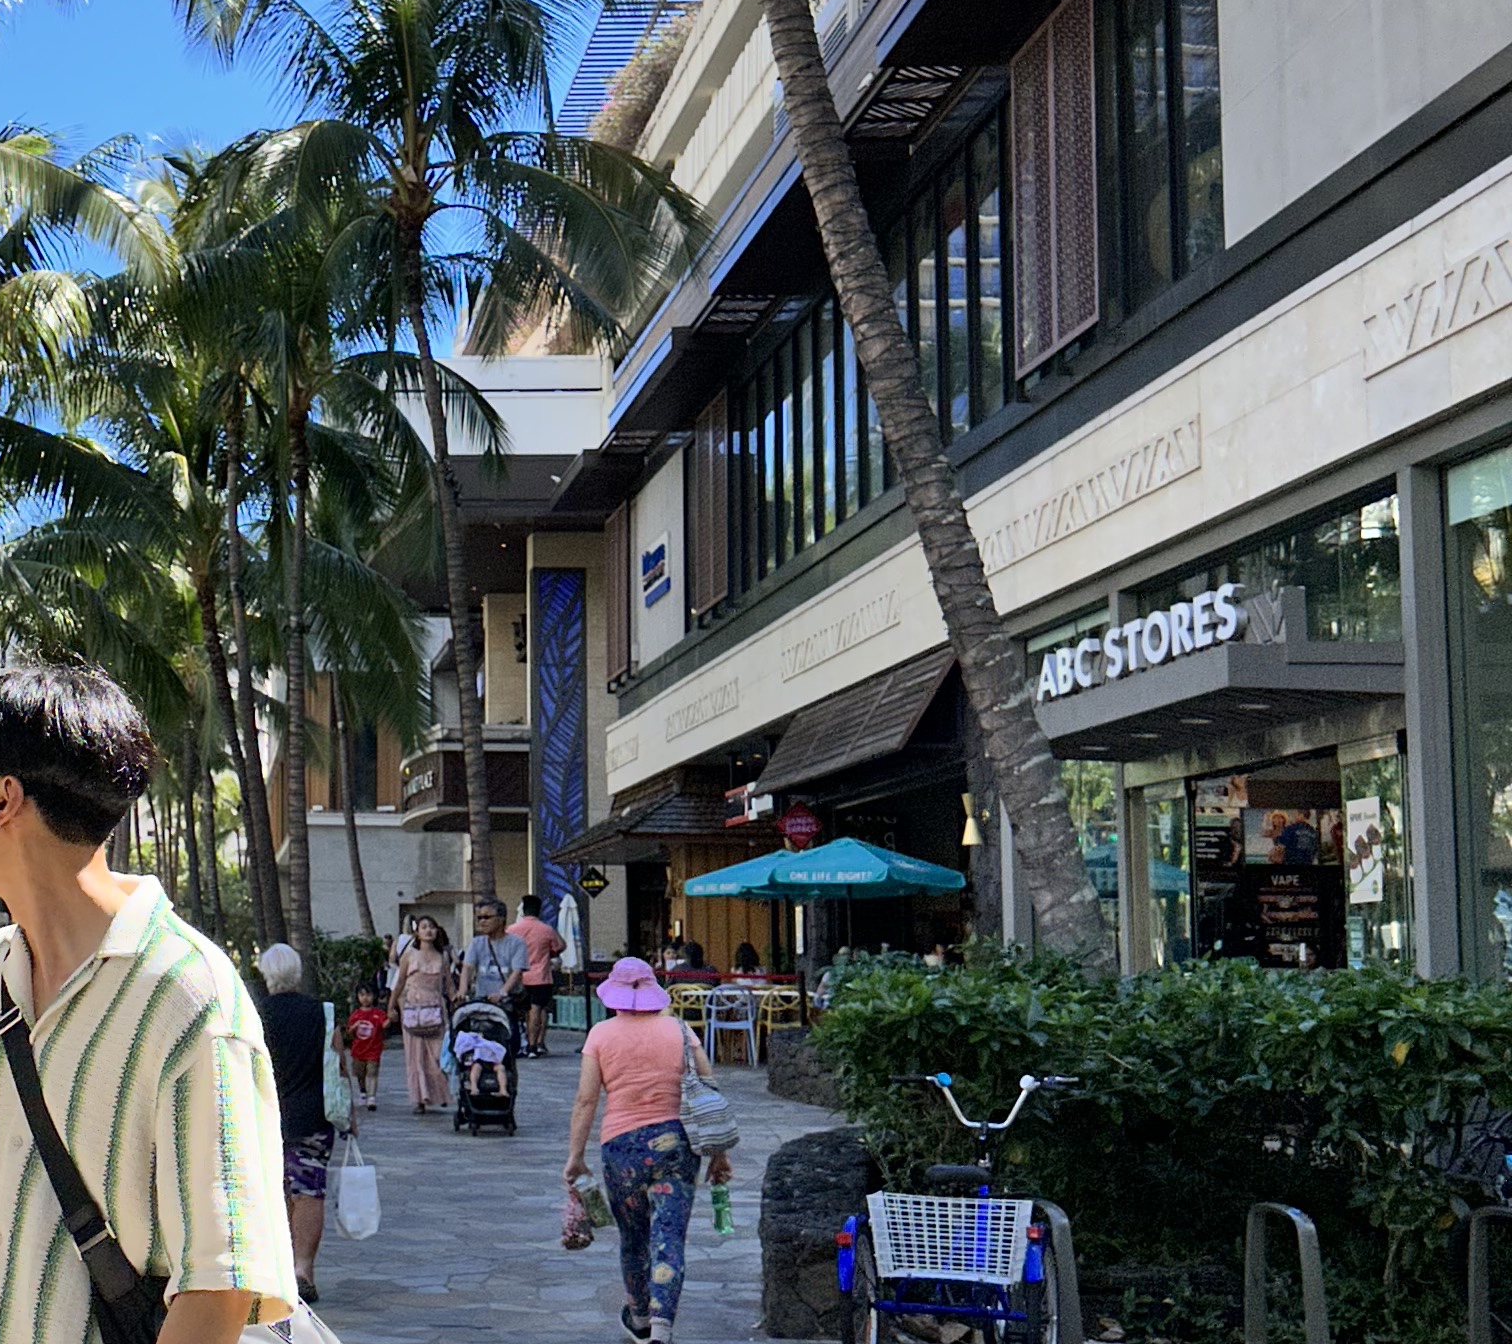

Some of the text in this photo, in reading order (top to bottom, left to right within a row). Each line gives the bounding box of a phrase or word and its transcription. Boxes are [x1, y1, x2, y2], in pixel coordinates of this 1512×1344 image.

[1037, 583, 1240, 701] ABC STORES
[1270, 874, 1300, 887] VAPE
